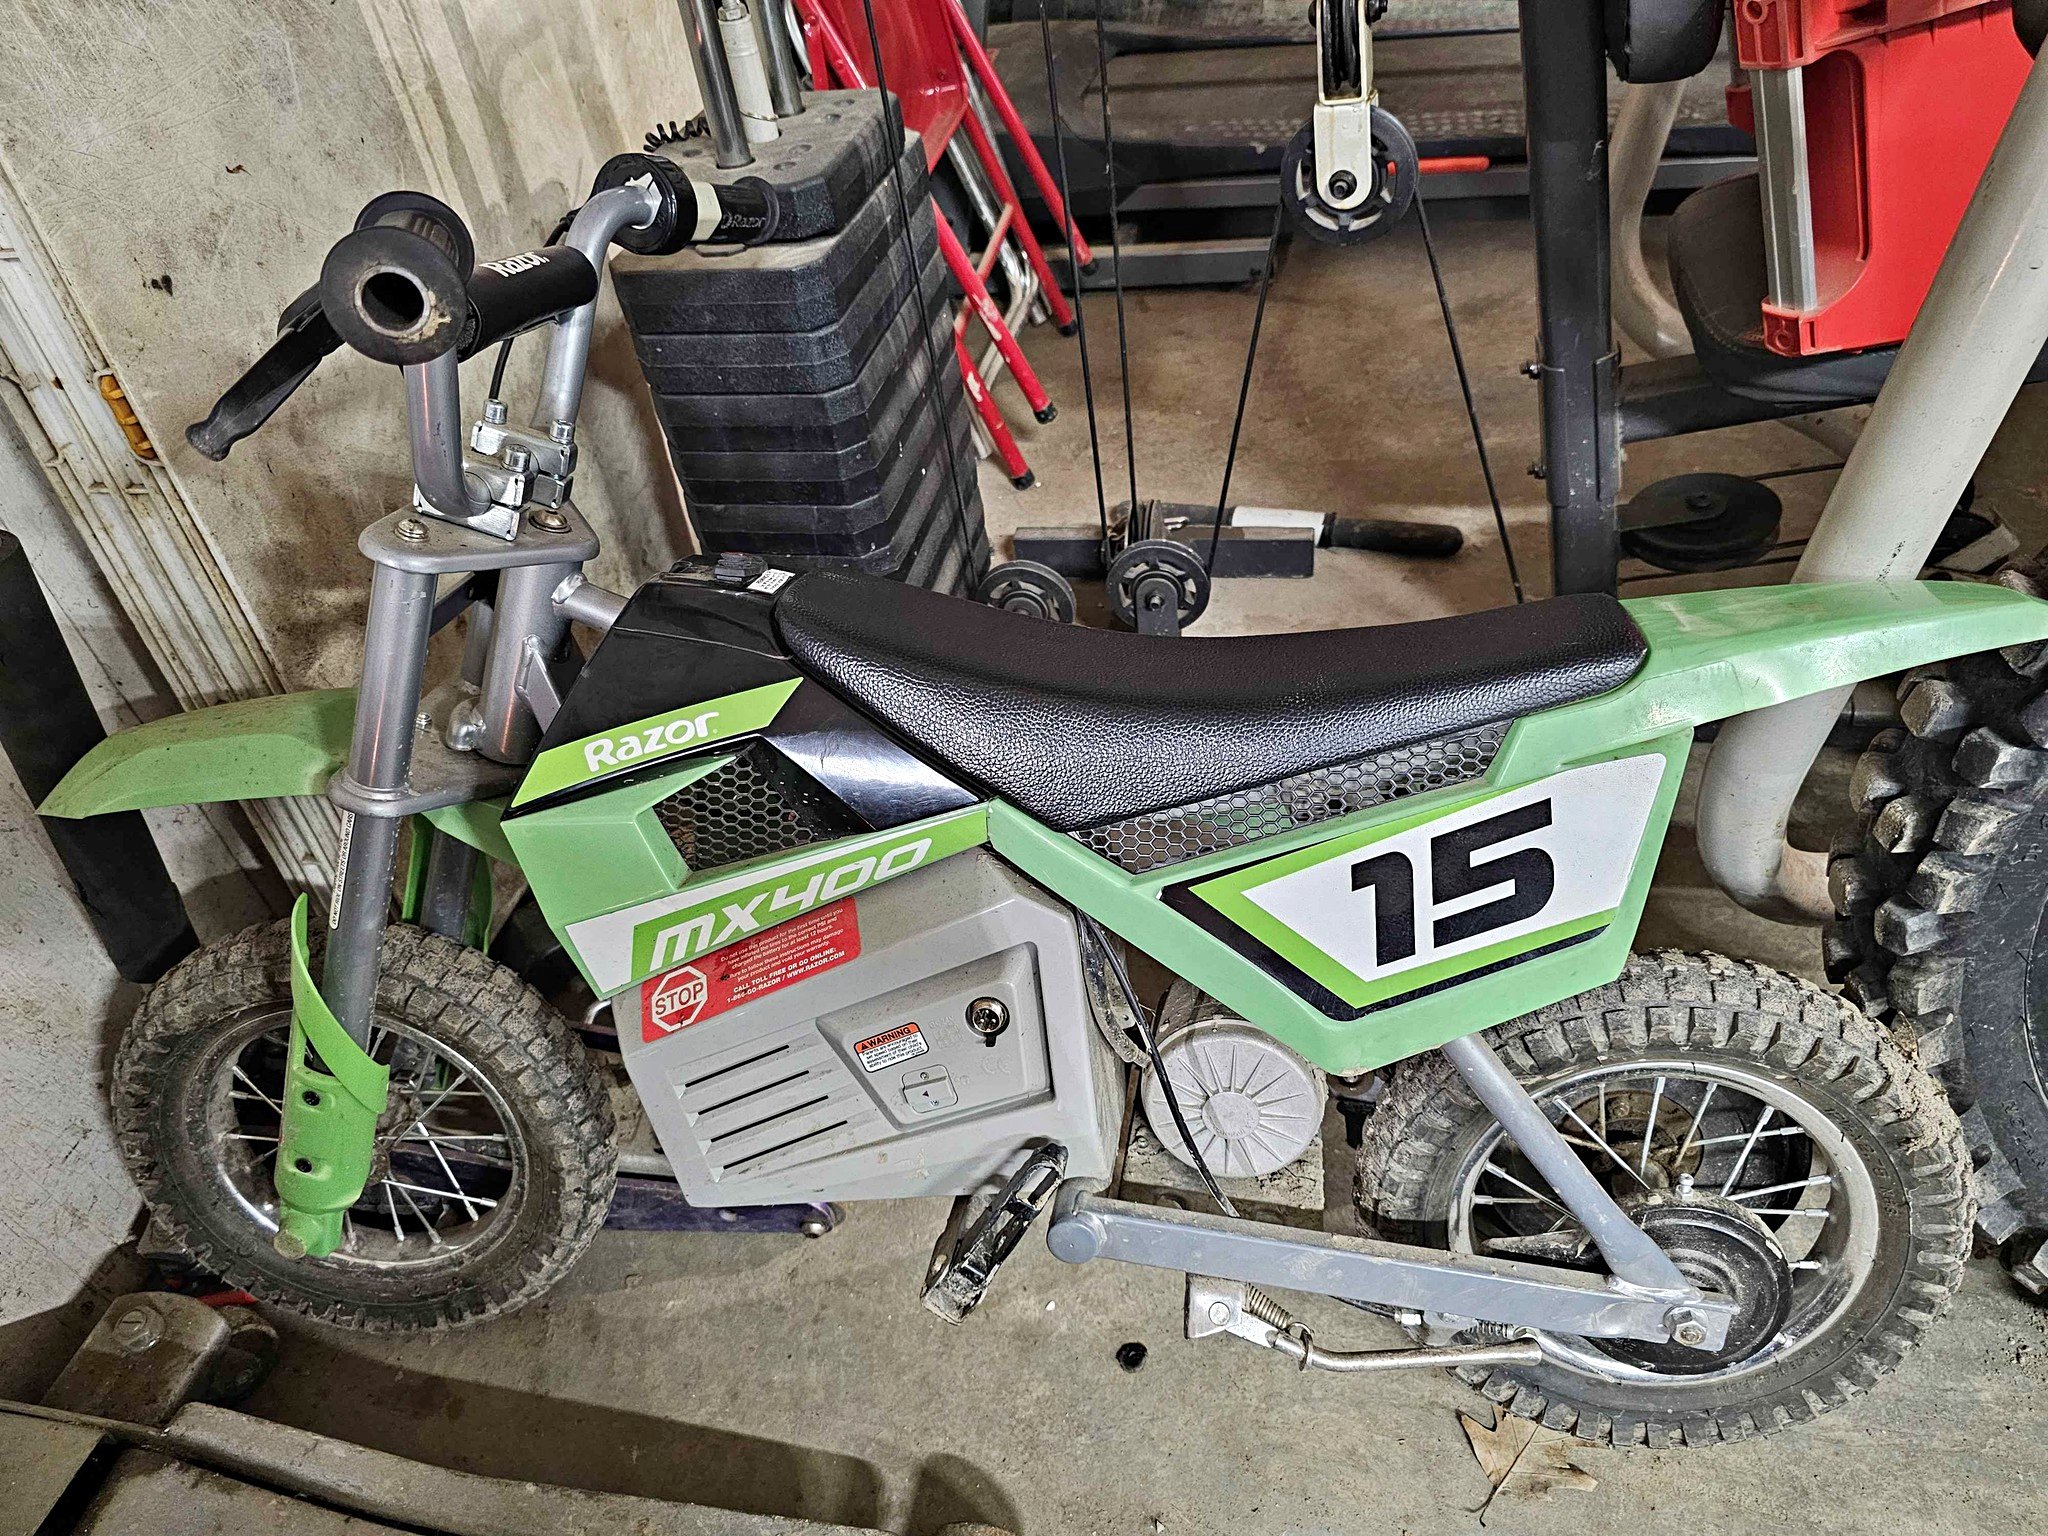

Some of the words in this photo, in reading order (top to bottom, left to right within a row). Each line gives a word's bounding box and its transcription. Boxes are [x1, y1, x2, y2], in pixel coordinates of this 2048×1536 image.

[478, 251, 548, 277] Razor
[583, 711, 720, 773] Razor
[1351, 797, 1554, 967] 15
[758, 934, 778, 947] product
[833, 908, 843, 916] you
[778, 942, 810, 958] instructions
[785, 950, 845, 979] WWW.RAZOR.COM
[733, 982, 749, 993] CALL
[752, 974, 767, 986] TOLL
[769, 967, 786, 978] FREE
[787, 962, 797, 971] OR
[799, 958, 808, 966] GO
[655, 983, 705, 1016] STOP
[867, 1026, 911, 1047] WARNING
